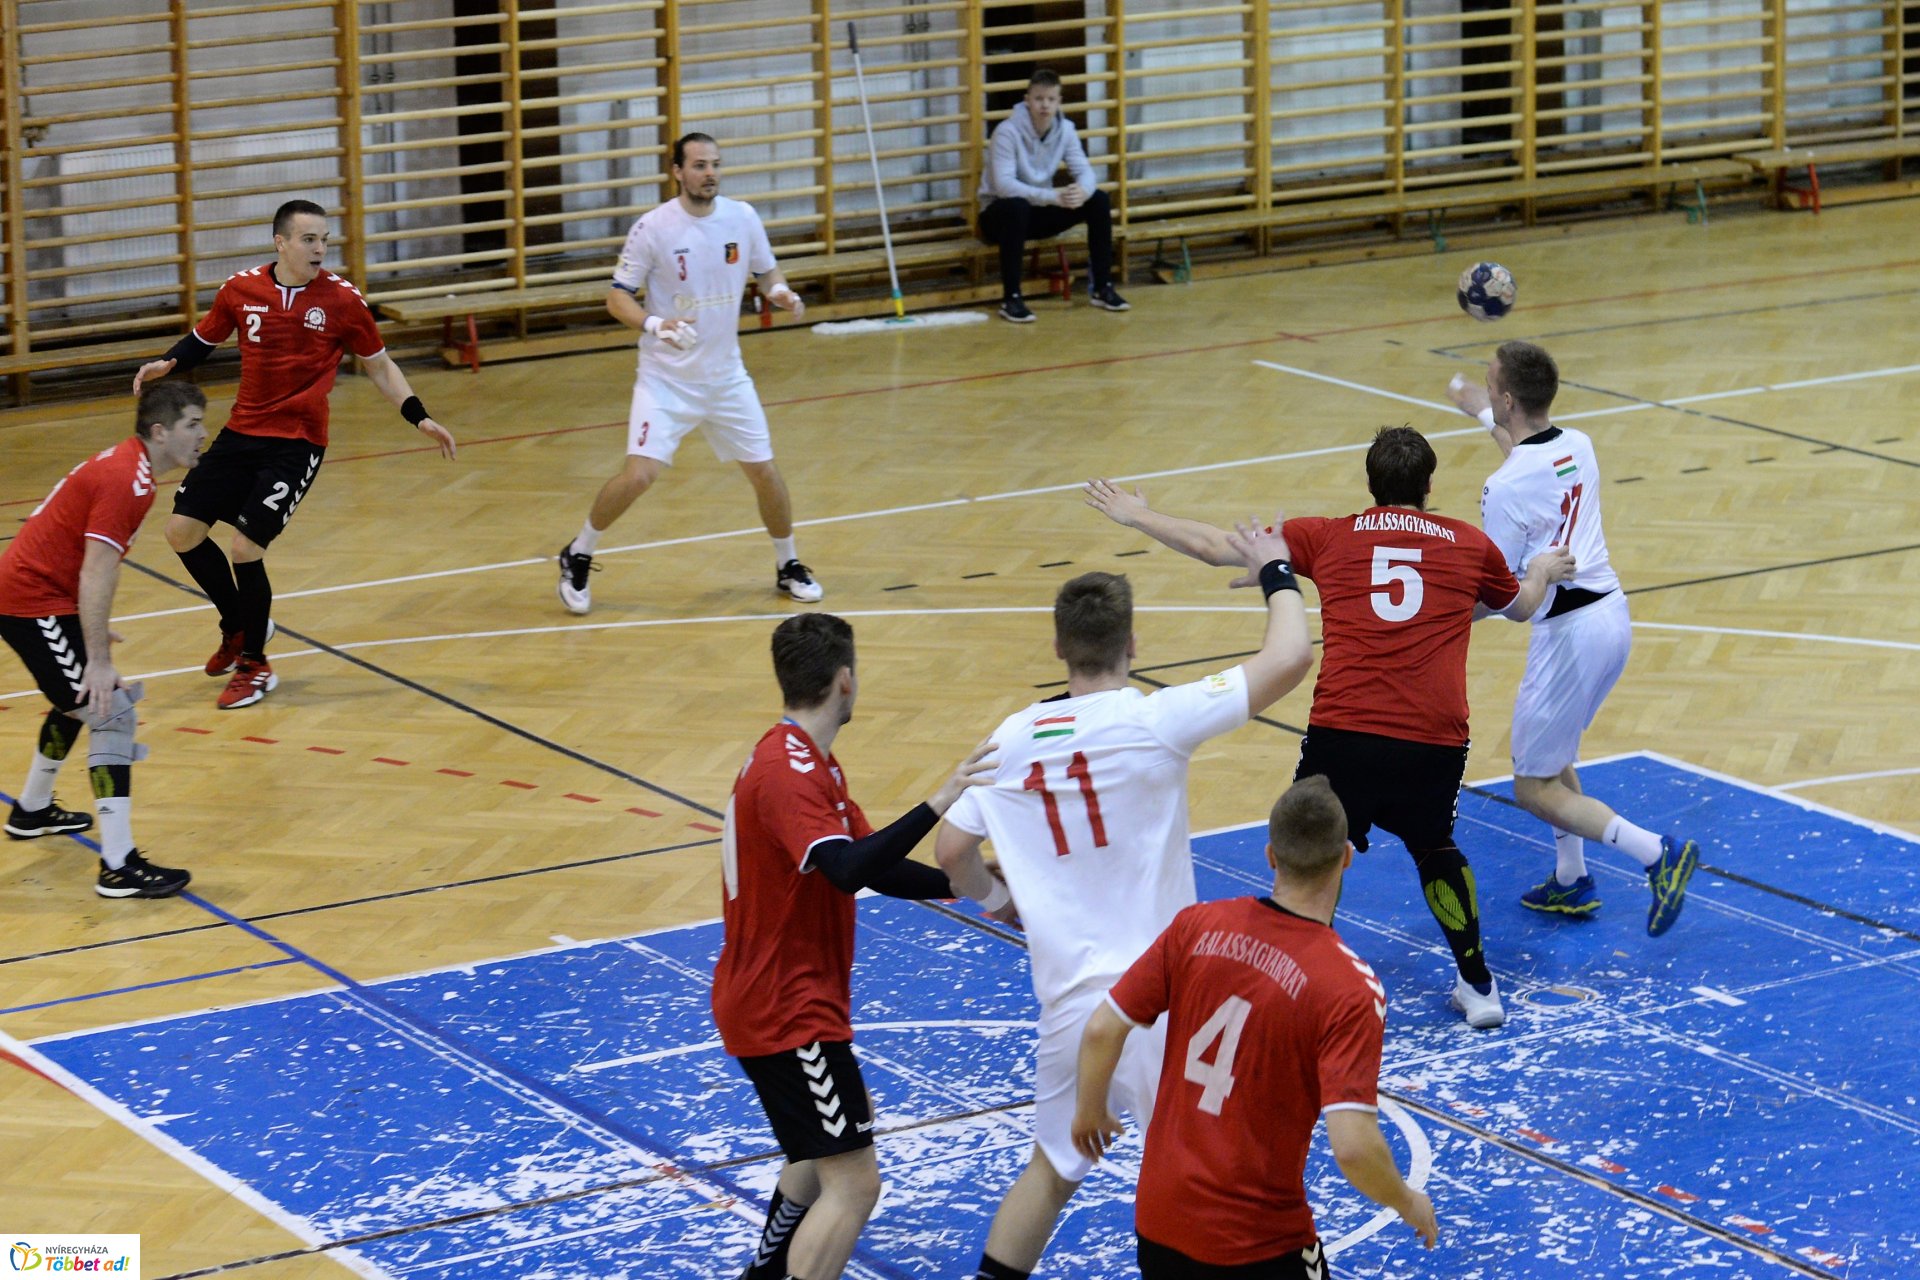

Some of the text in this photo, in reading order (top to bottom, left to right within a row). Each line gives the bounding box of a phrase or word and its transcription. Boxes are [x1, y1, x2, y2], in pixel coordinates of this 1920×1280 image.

[678, 255, 687, 281] 3
[242, 304, 269, 313] hummel
[246, 313, 261, 343] 2
[638, 421, 649, 447] 3
[262, 481, 289, 511] 2
[1353, 512, 1456, 543] BALASSAGYARMAT
[1370, 546, 1424, 622] 5
[1023, 751, 1109, 856] 11
[1192, 930, 1308, 1001] BALASSAGYARMAT
[1184, 994, 1253, 1117] 4
